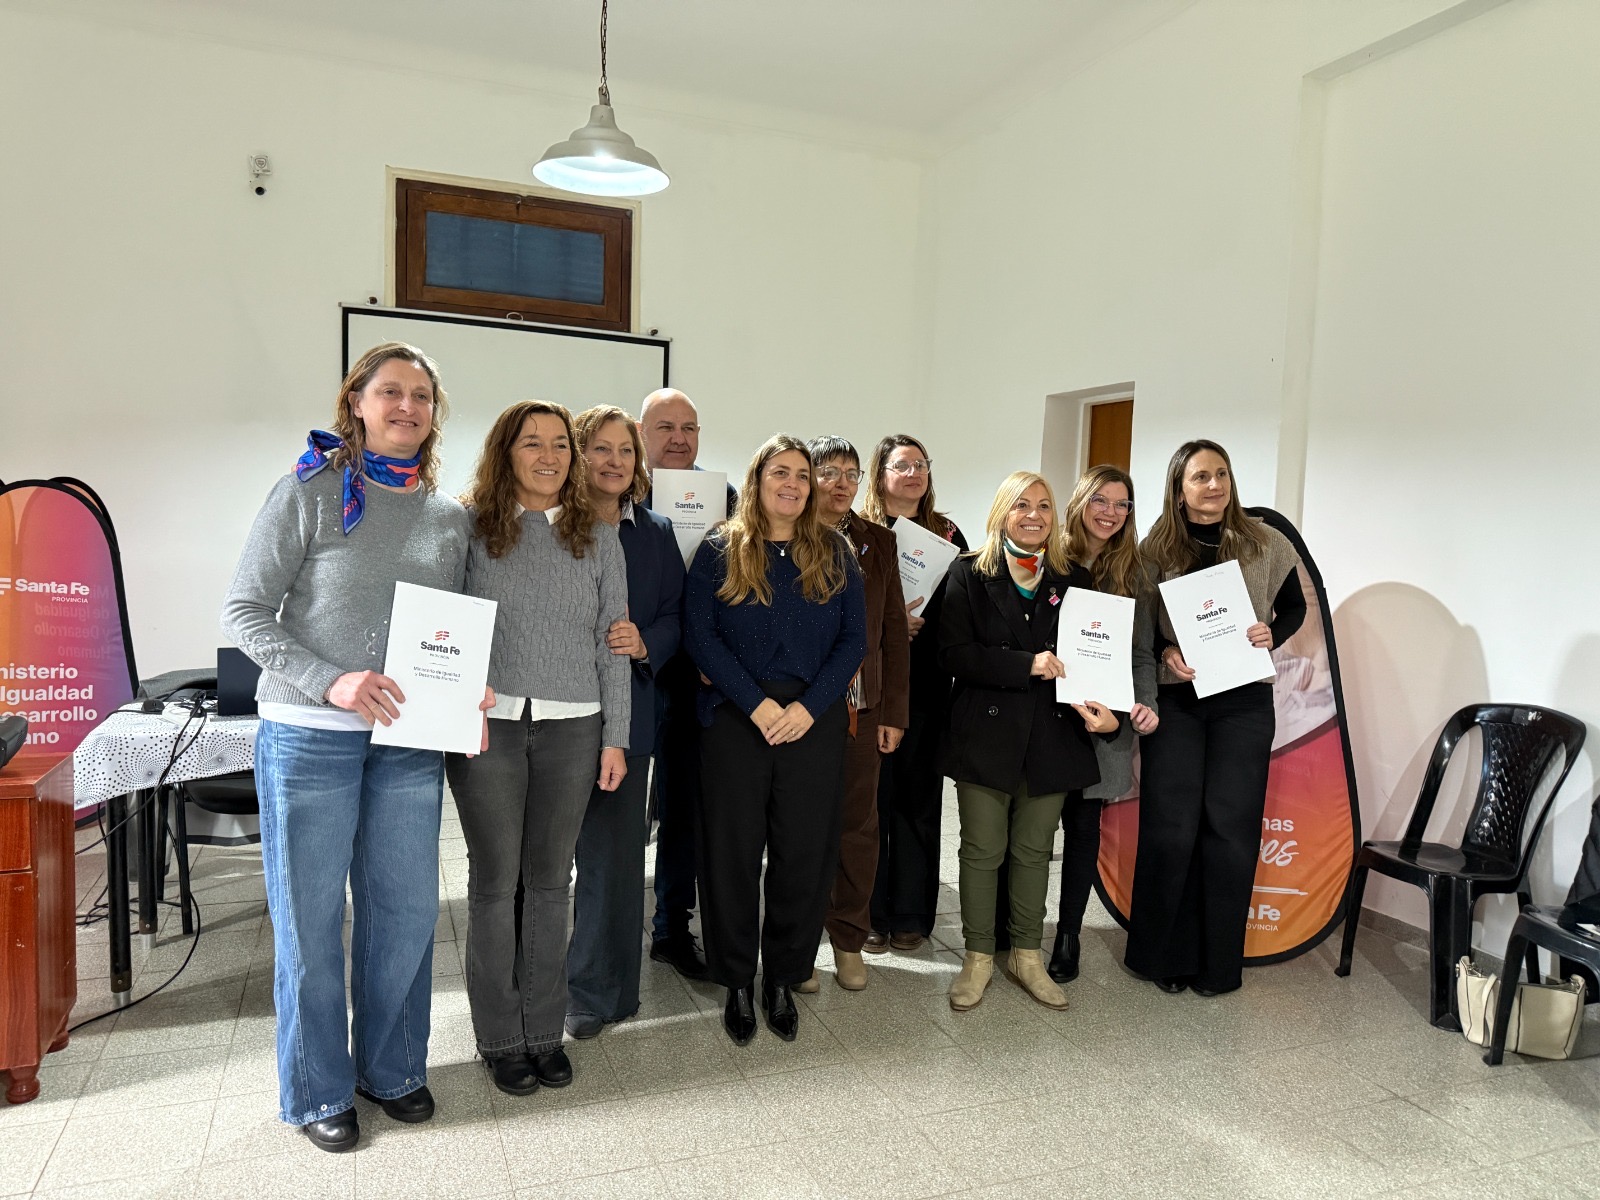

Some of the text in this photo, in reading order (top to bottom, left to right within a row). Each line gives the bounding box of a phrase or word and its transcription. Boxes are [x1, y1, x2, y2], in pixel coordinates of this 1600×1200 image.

[901, 551, 919, 566] Santa
[918, 561, 926, 570] Fe
[15, 578, 68, 594] Santa
[70, 582, 90, 596] Fe
[51, 596, 89, 604] PROVINCIA
[1196, 611, 1219, 621] Santa
[1081, 629, 1101, 638] Santa
[421, 641, 460, 655] Santa Fe
[0, 662, 78, 679] nisterio
[0, 685, 93, 705] Igualdad
[0, 706, 98, 723] sarrollo
[1262, 817, 1294, 832] nas
[1257, 904, 1281, 922] Fe
[1246, 922, 1279, 932] OVINCIA
